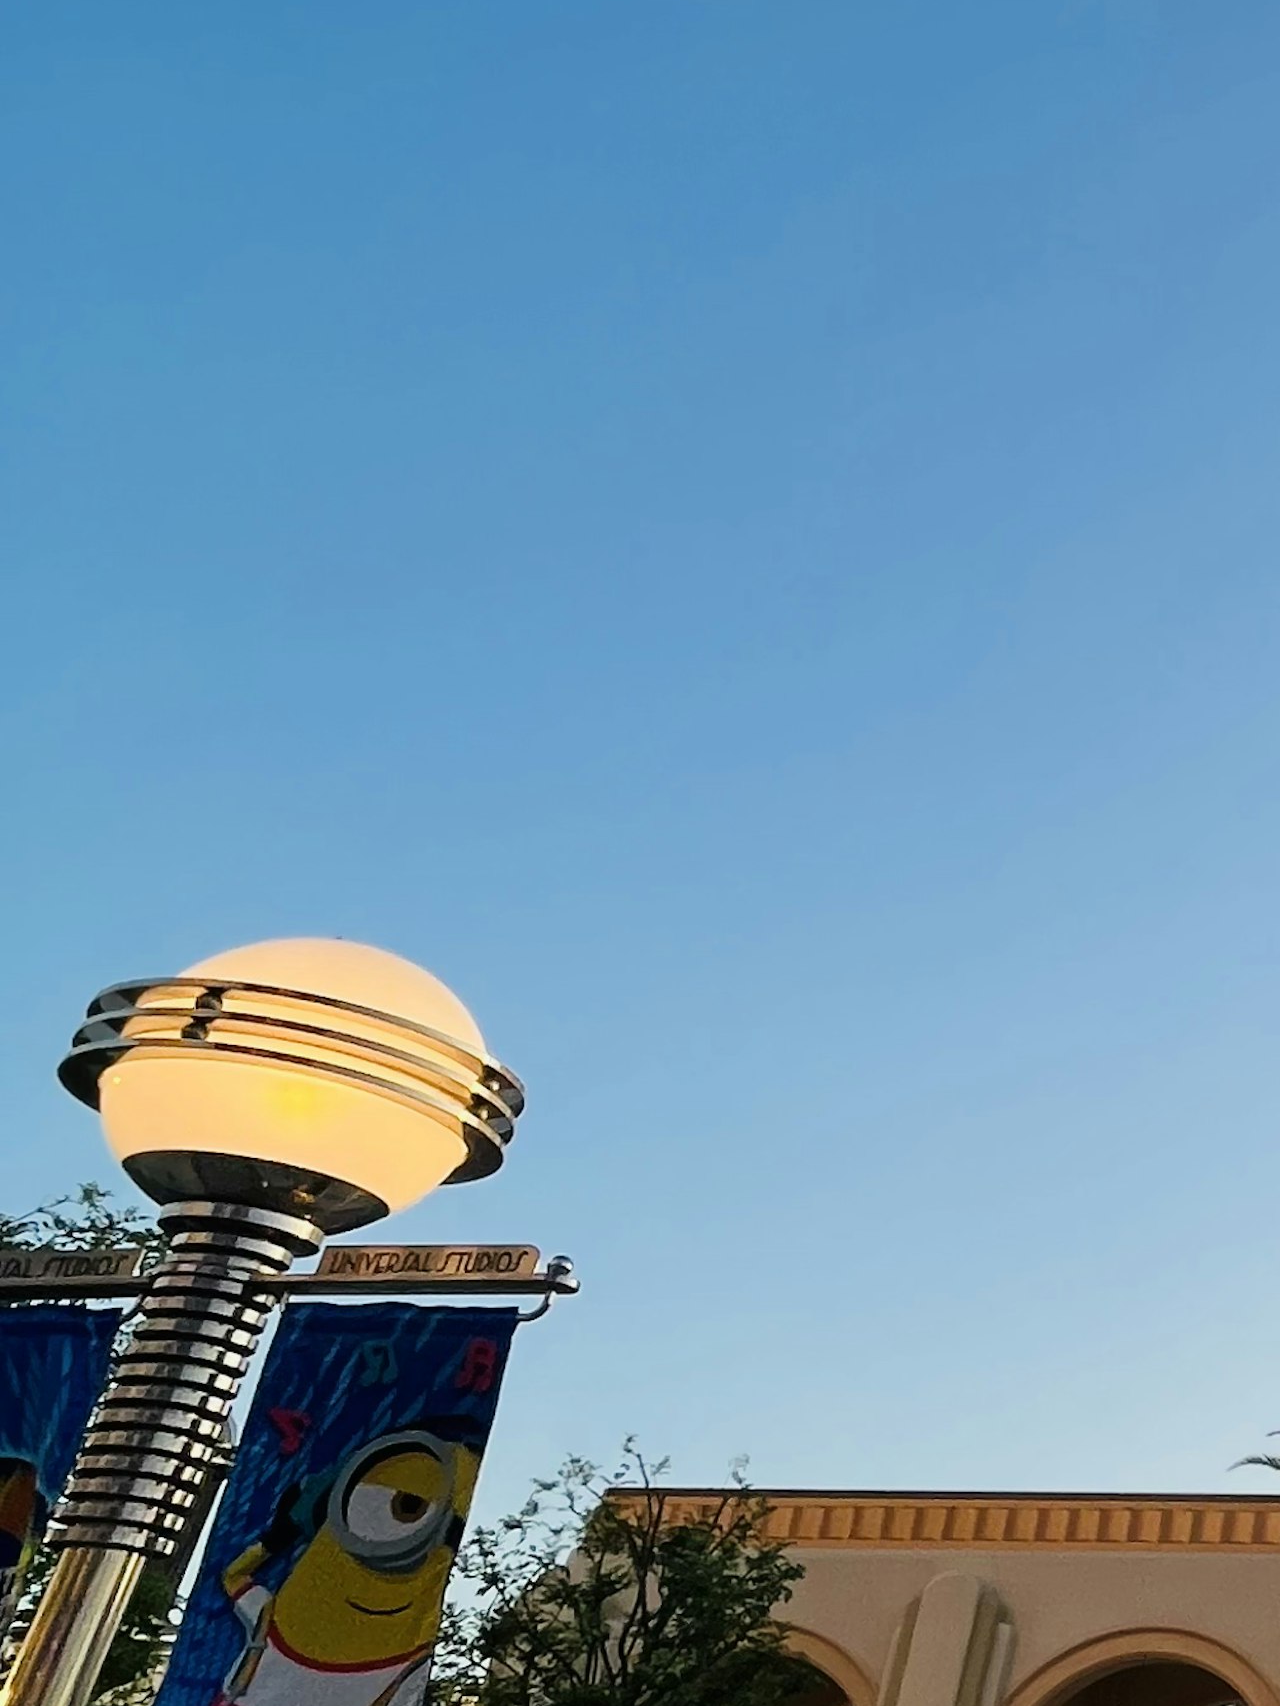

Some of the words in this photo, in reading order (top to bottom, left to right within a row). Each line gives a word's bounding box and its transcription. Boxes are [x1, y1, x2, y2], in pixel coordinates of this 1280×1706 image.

[38, 1255, 129, 1278] STUDIOS
[328, 1250, 430, 1275] UNIVERSAL
[436, 1250, 529, 1274] STUDIOS
